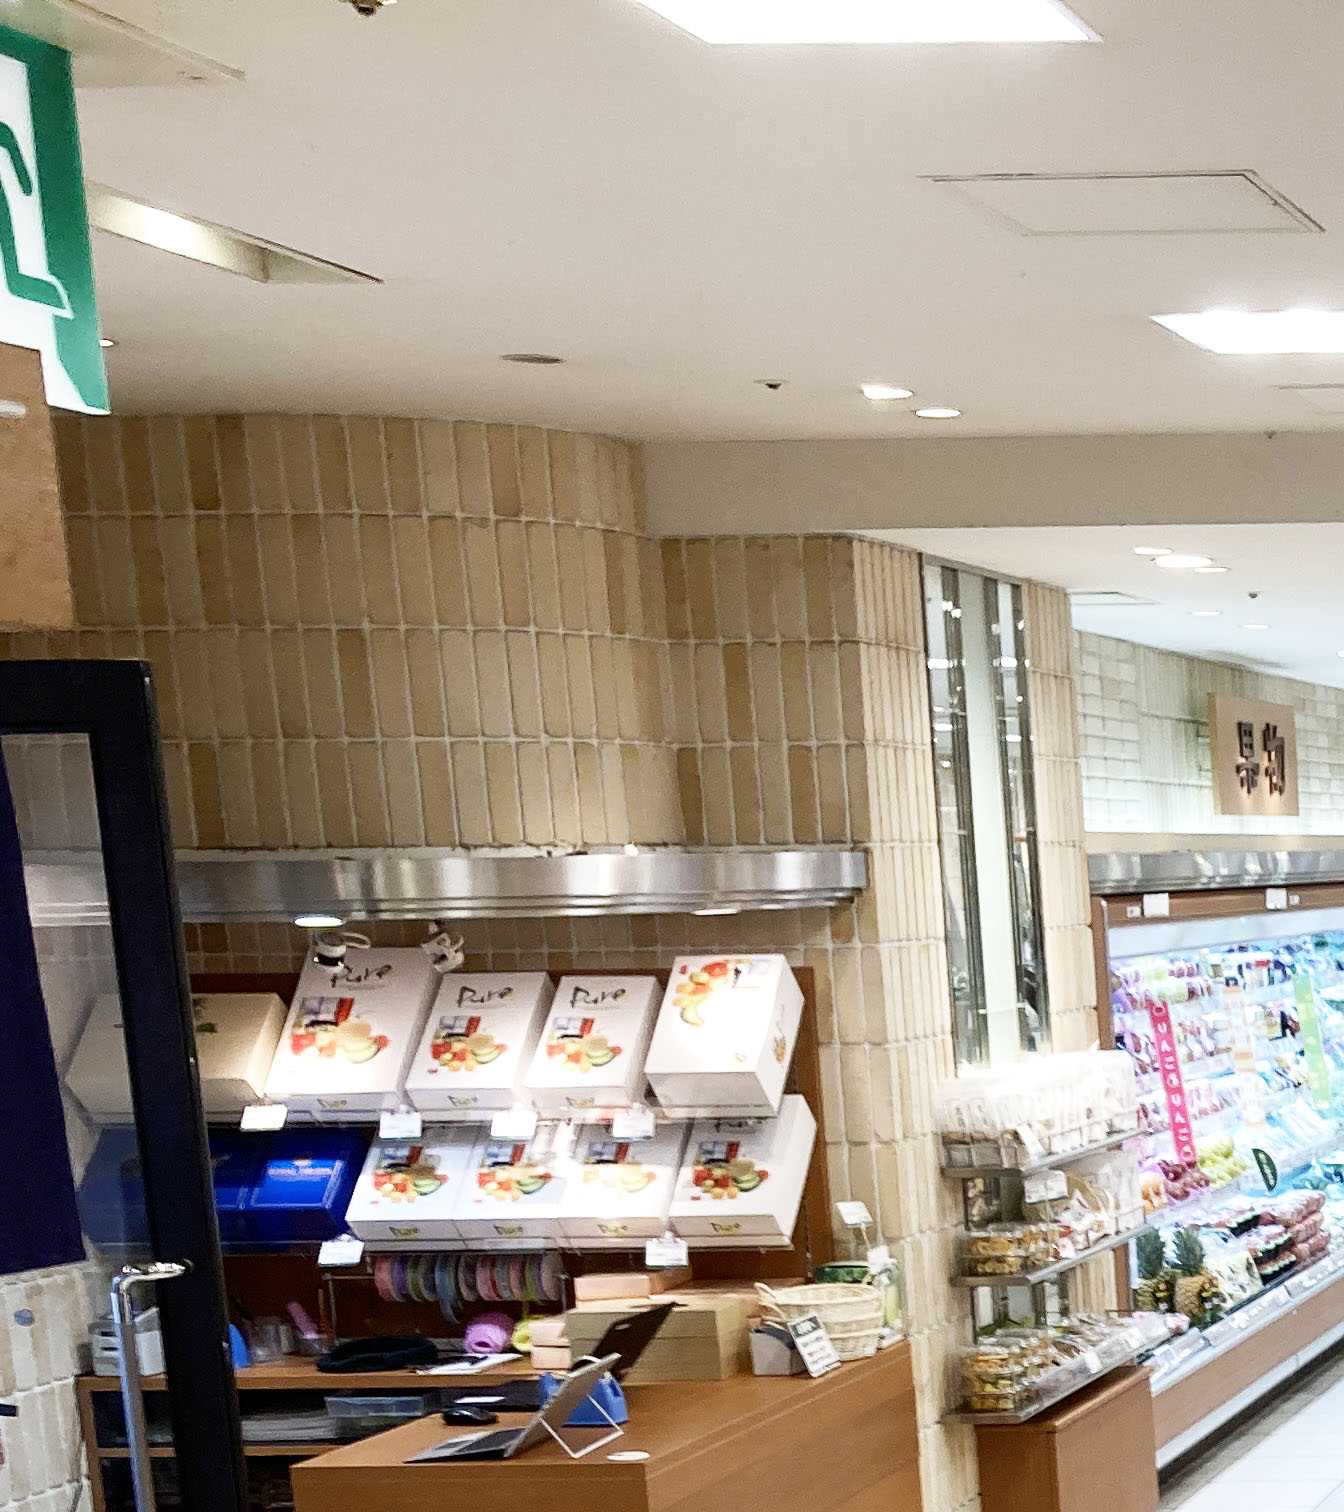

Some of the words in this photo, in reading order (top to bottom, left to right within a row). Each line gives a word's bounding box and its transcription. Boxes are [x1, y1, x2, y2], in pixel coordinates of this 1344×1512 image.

[1235, 721, 1286, 797] 果物
[330, 964, 393, 988] Pure
[457, 985, 514, 1008] Pure
[570, 986, 627, 1008] Pure
